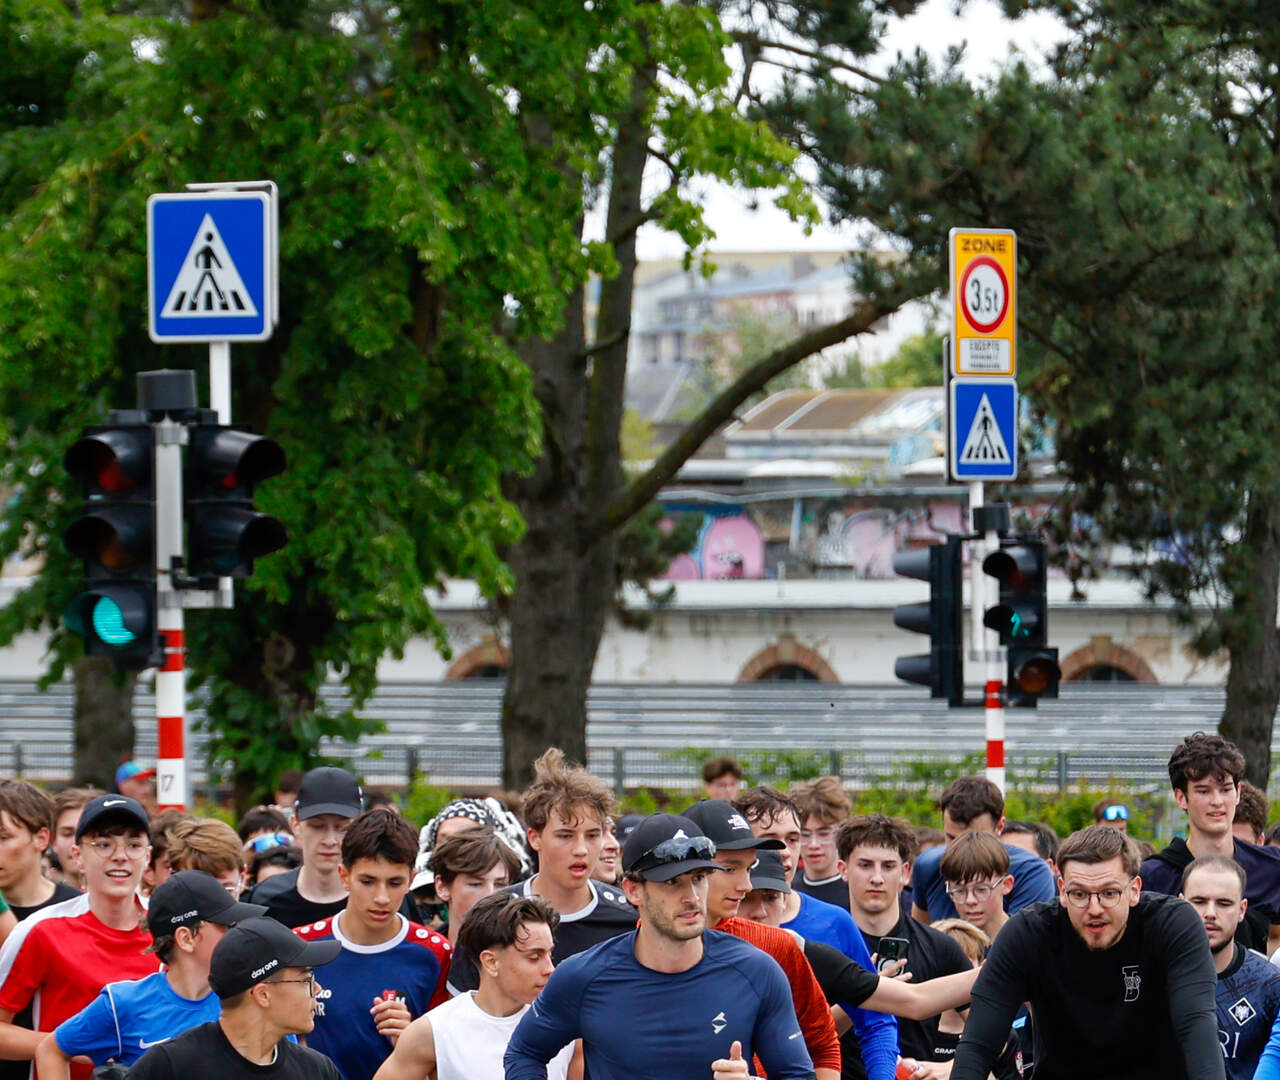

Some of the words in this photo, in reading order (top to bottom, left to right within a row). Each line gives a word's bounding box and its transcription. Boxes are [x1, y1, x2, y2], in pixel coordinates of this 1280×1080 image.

[962, 238, 1006, 253] ZONE
[250, 967, 266, 979] day
[265, 959, 279, 971] one
